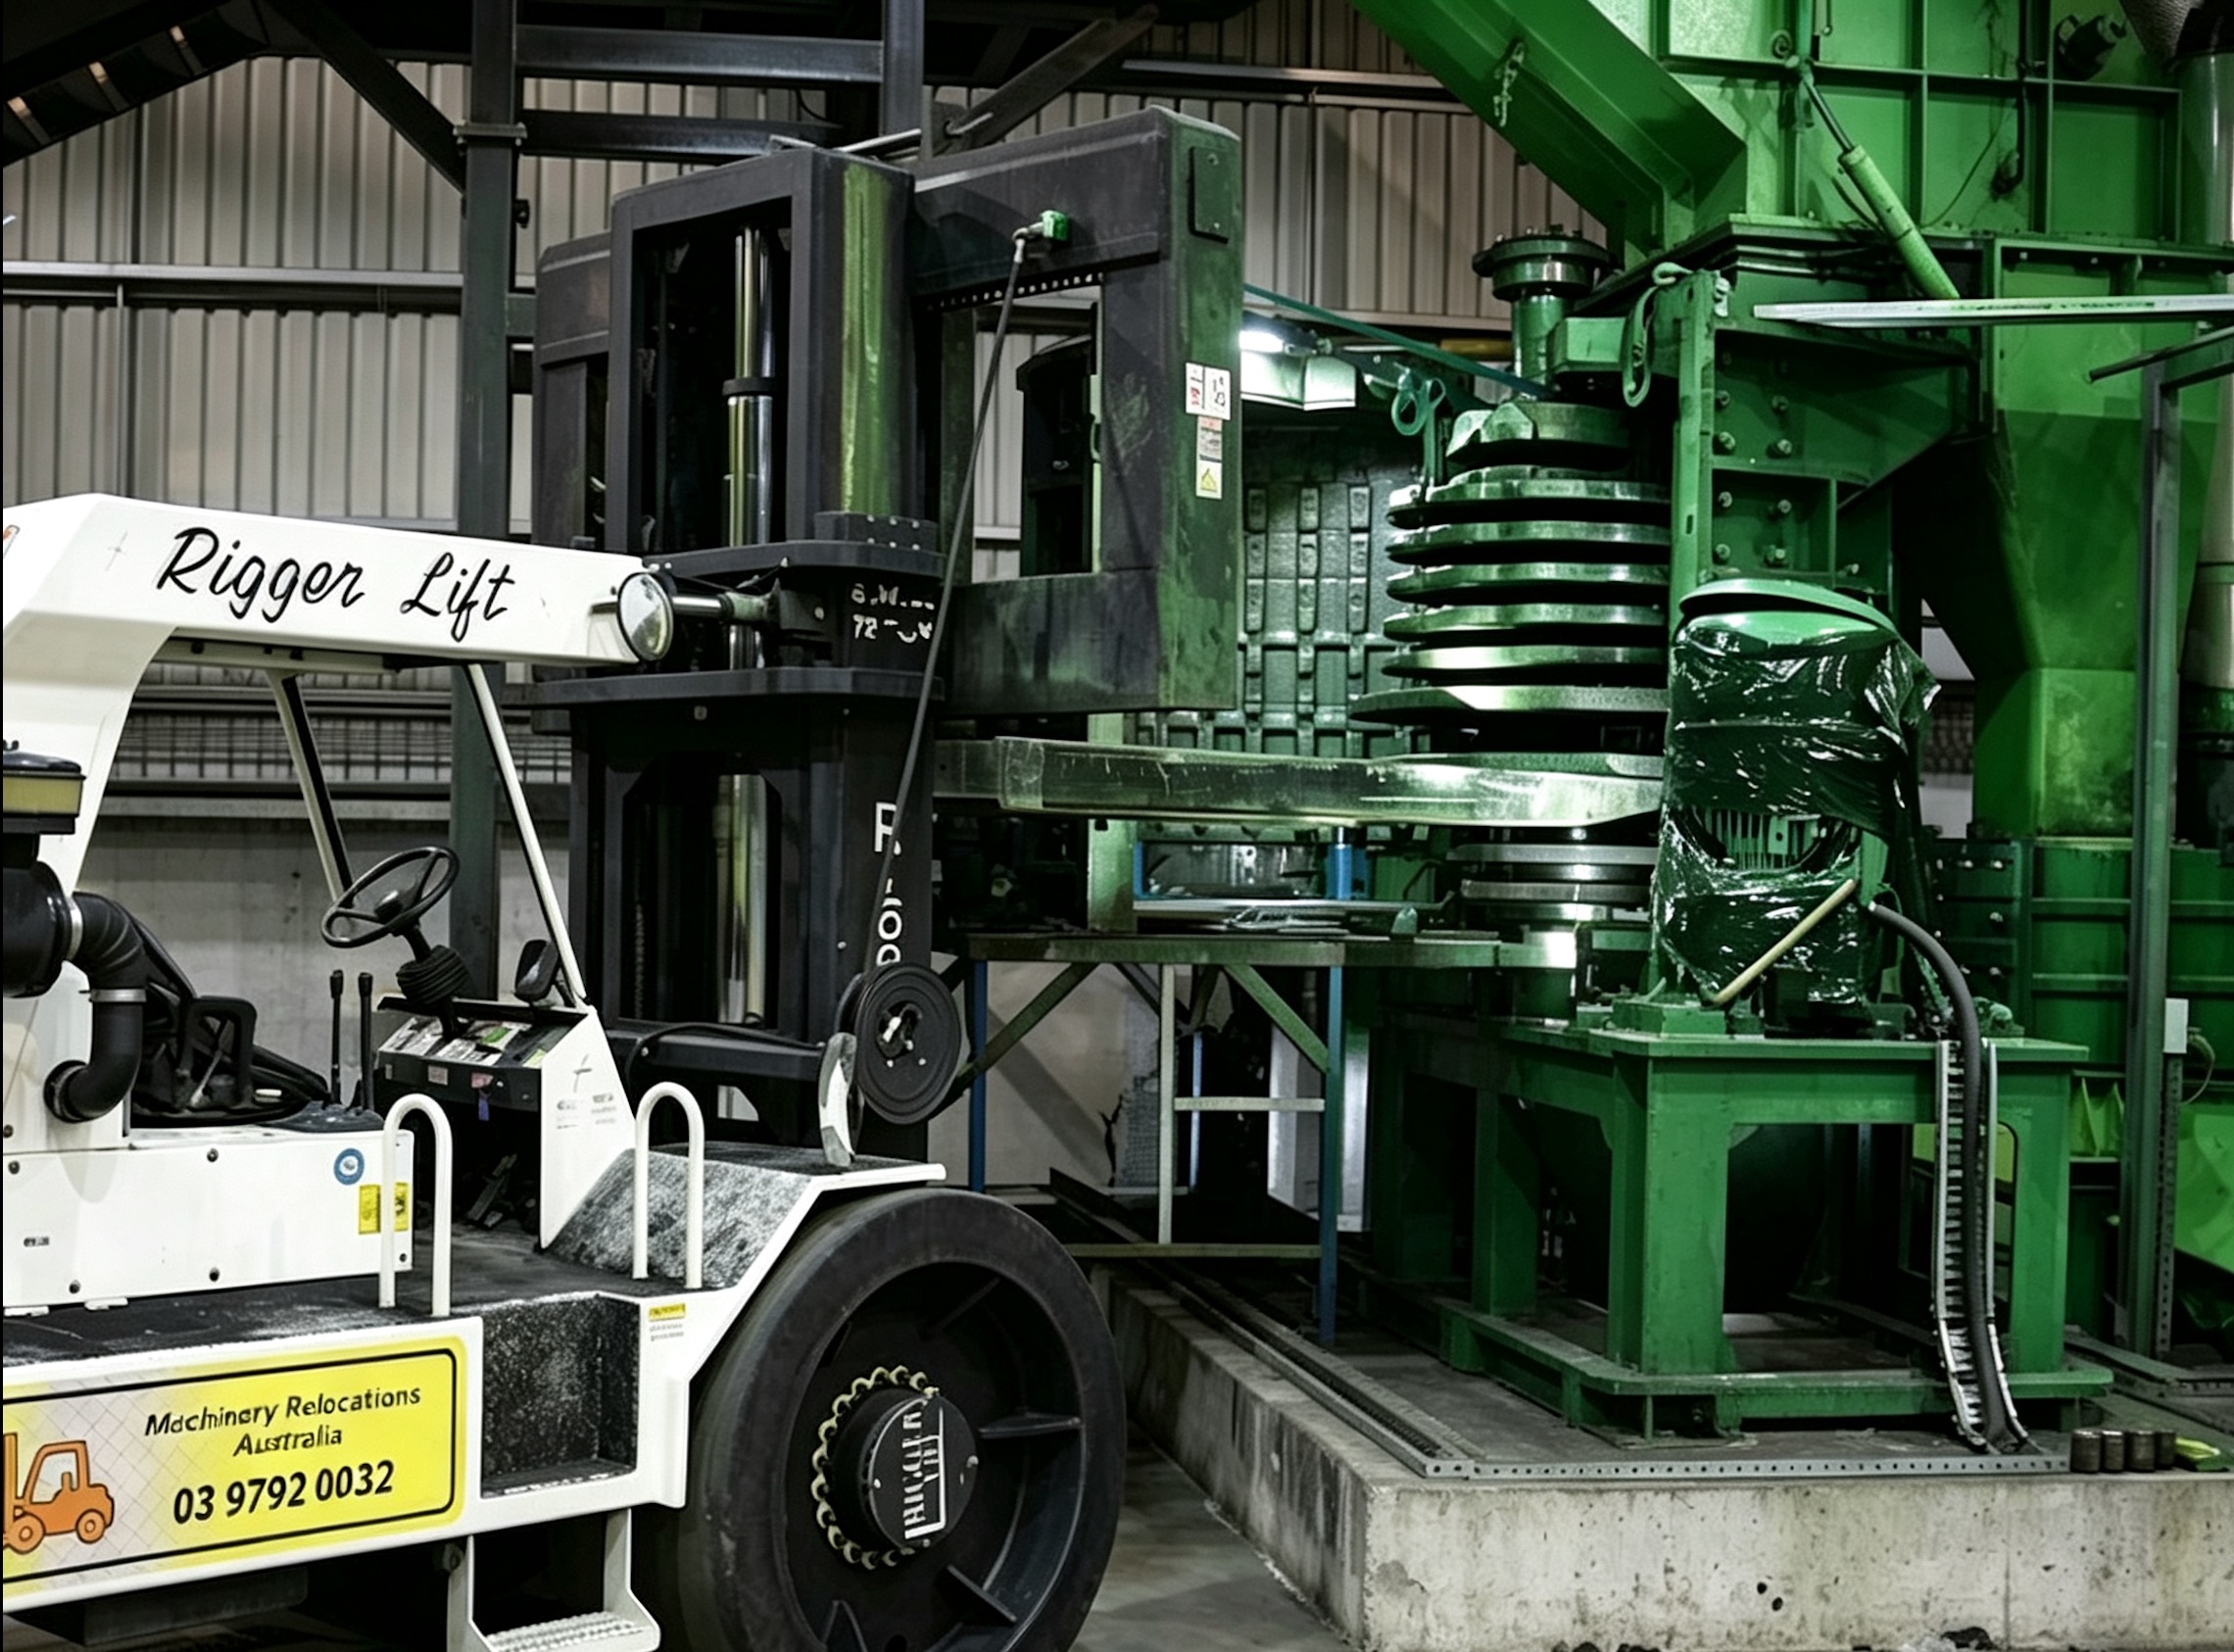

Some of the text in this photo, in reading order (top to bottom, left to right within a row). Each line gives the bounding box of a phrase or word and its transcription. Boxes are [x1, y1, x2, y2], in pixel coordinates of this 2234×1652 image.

[157, 526, 515, 643] Rigger Lift
[144, 1387, 421, 1436] Machinery Relocations
[232, 1424, 343, 1457] Australia
[173, 1459, 394, 1525] 03 9792 0032
